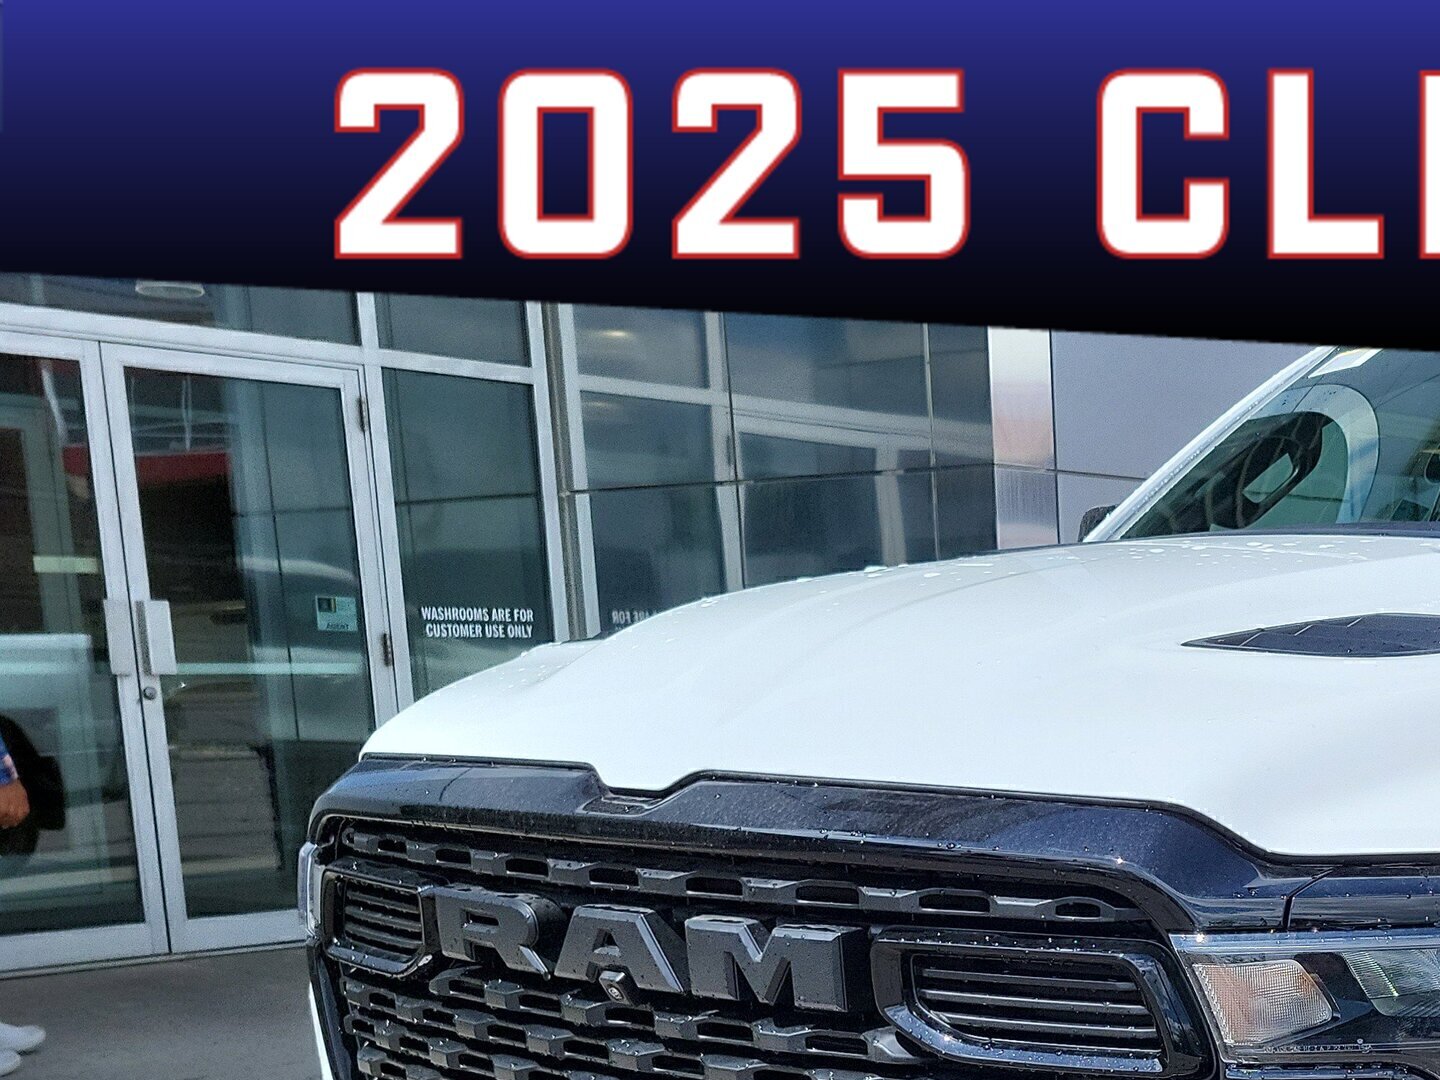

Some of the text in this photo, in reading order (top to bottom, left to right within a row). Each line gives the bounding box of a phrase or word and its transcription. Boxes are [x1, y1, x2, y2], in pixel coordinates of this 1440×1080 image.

[421, 606, 534, 622] WASHROOMS ARE FOR
[426, 623, 533, 638] CUSTOMER USE ONLY
[435, 884, 863, 1012] RAM
